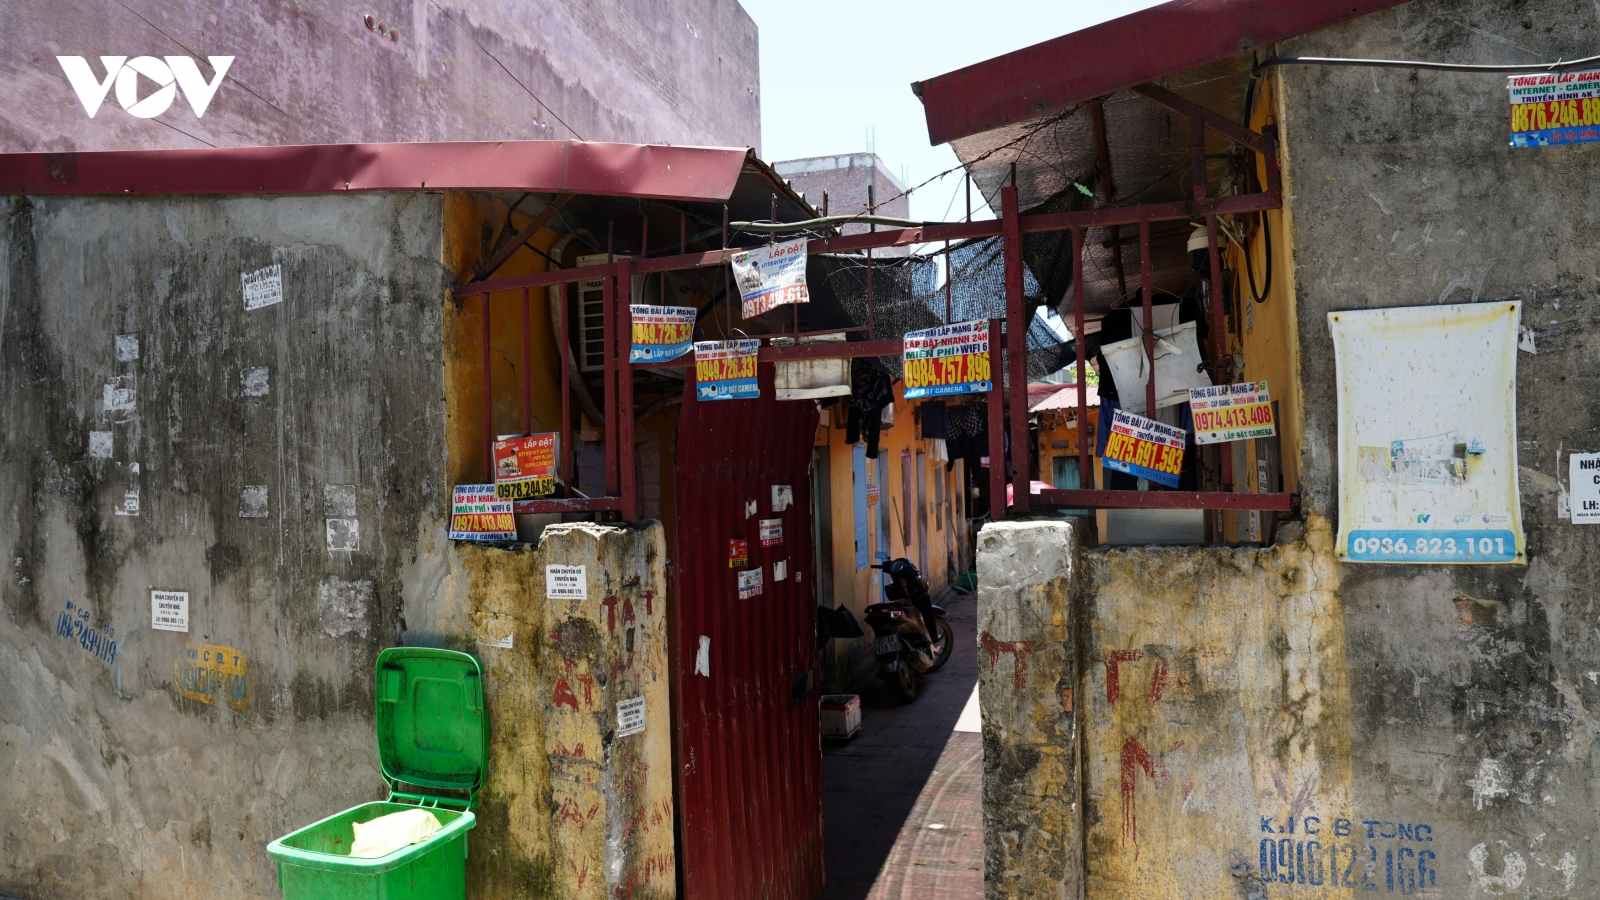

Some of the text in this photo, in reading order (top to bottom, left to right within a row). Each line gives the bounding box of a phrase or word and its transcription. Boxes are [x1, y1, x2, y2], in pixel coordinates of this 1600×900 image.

[1513, 86, 1557, 96] INTERNET
[1557, 92, 1579, 100] HÌNH
[769, 246, 786, 258] LẮP
[787, 242, 805, 254] ĐẶT
[762, 257, 788, 268] INTERNET
[676, 308, 696, 316] MẠNG
[952, 324, 972, 335] MẠNG
[941, 336, 970, 346] NHANH
[972, 333, 988, 342] 24H
[937, 346, 955, 356] PHÍ
[960, 343, 980, 354] WIFI
[982, 342, 988, 352] 6
[696, 356, 758, 382] 0949.726.331
[904, 352, 990, 388] 0984.757.896
[935, 386, 963, 394] CAMERA
[1194, 406, 1272, 431] 0974.413.408
[1113, 424, 1133, 436] INTERNET
[1154, 423, 1172, 436] MẠNG
[1248, 428, 1273, 436] CAMERA
[524, 438, 537, 448] LẮP
[538, 438, 553, 448] ĐẶT
[1106, 432, 1184, 474] 0975.691.593
[466, 494, 477, 504] ĐẶT
[506, 504, 511, 512] 6
[1583, 500, 1599, 510] LH:
[454, 514, 514, 531] 0974.413.408
